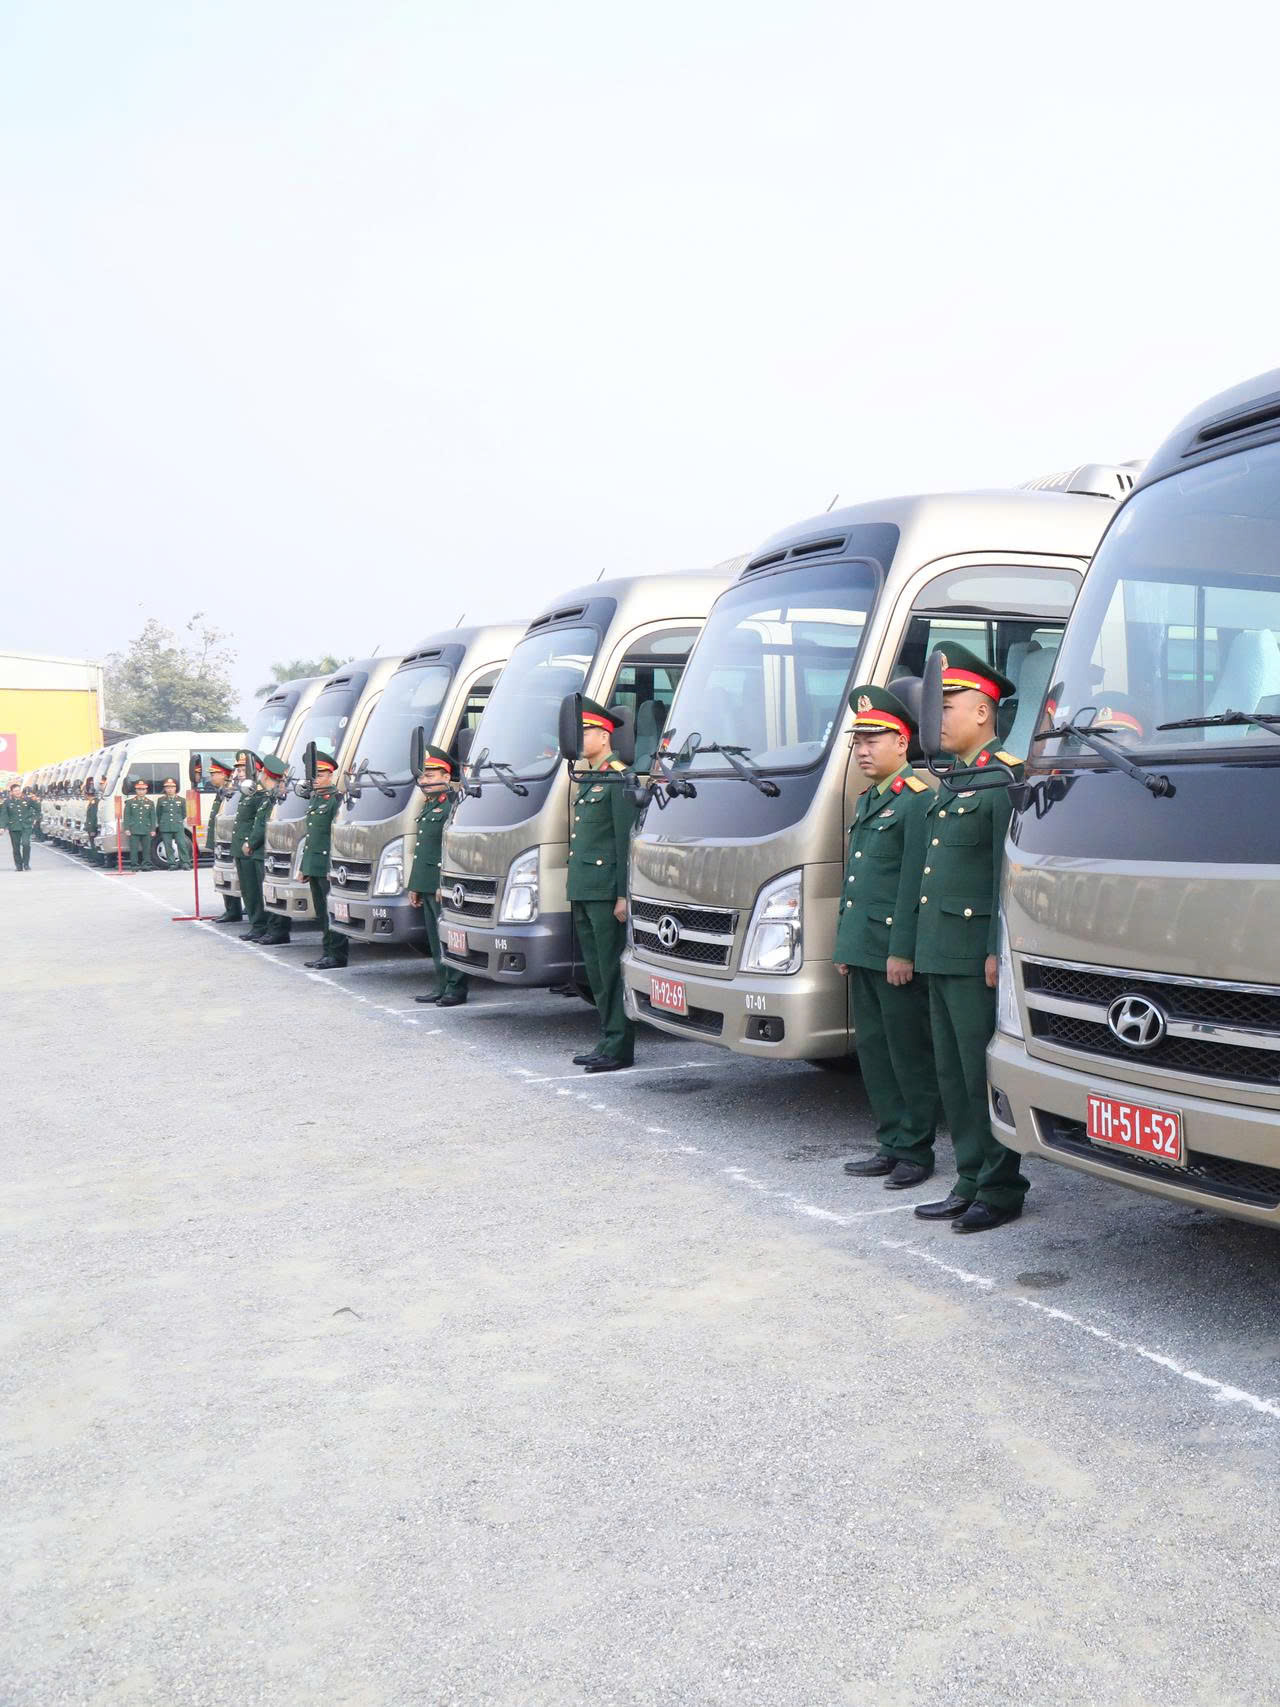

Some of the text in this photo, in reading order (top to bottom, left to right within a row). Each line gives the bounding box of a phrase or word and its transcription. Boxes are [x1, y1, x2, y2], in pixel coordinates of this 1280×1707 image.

[651, 979, 683, 1007] TH-92-69
[745, 994, 766, 1010] 07-01
[1090, 1099, 1176, 1154] TH-51-52
